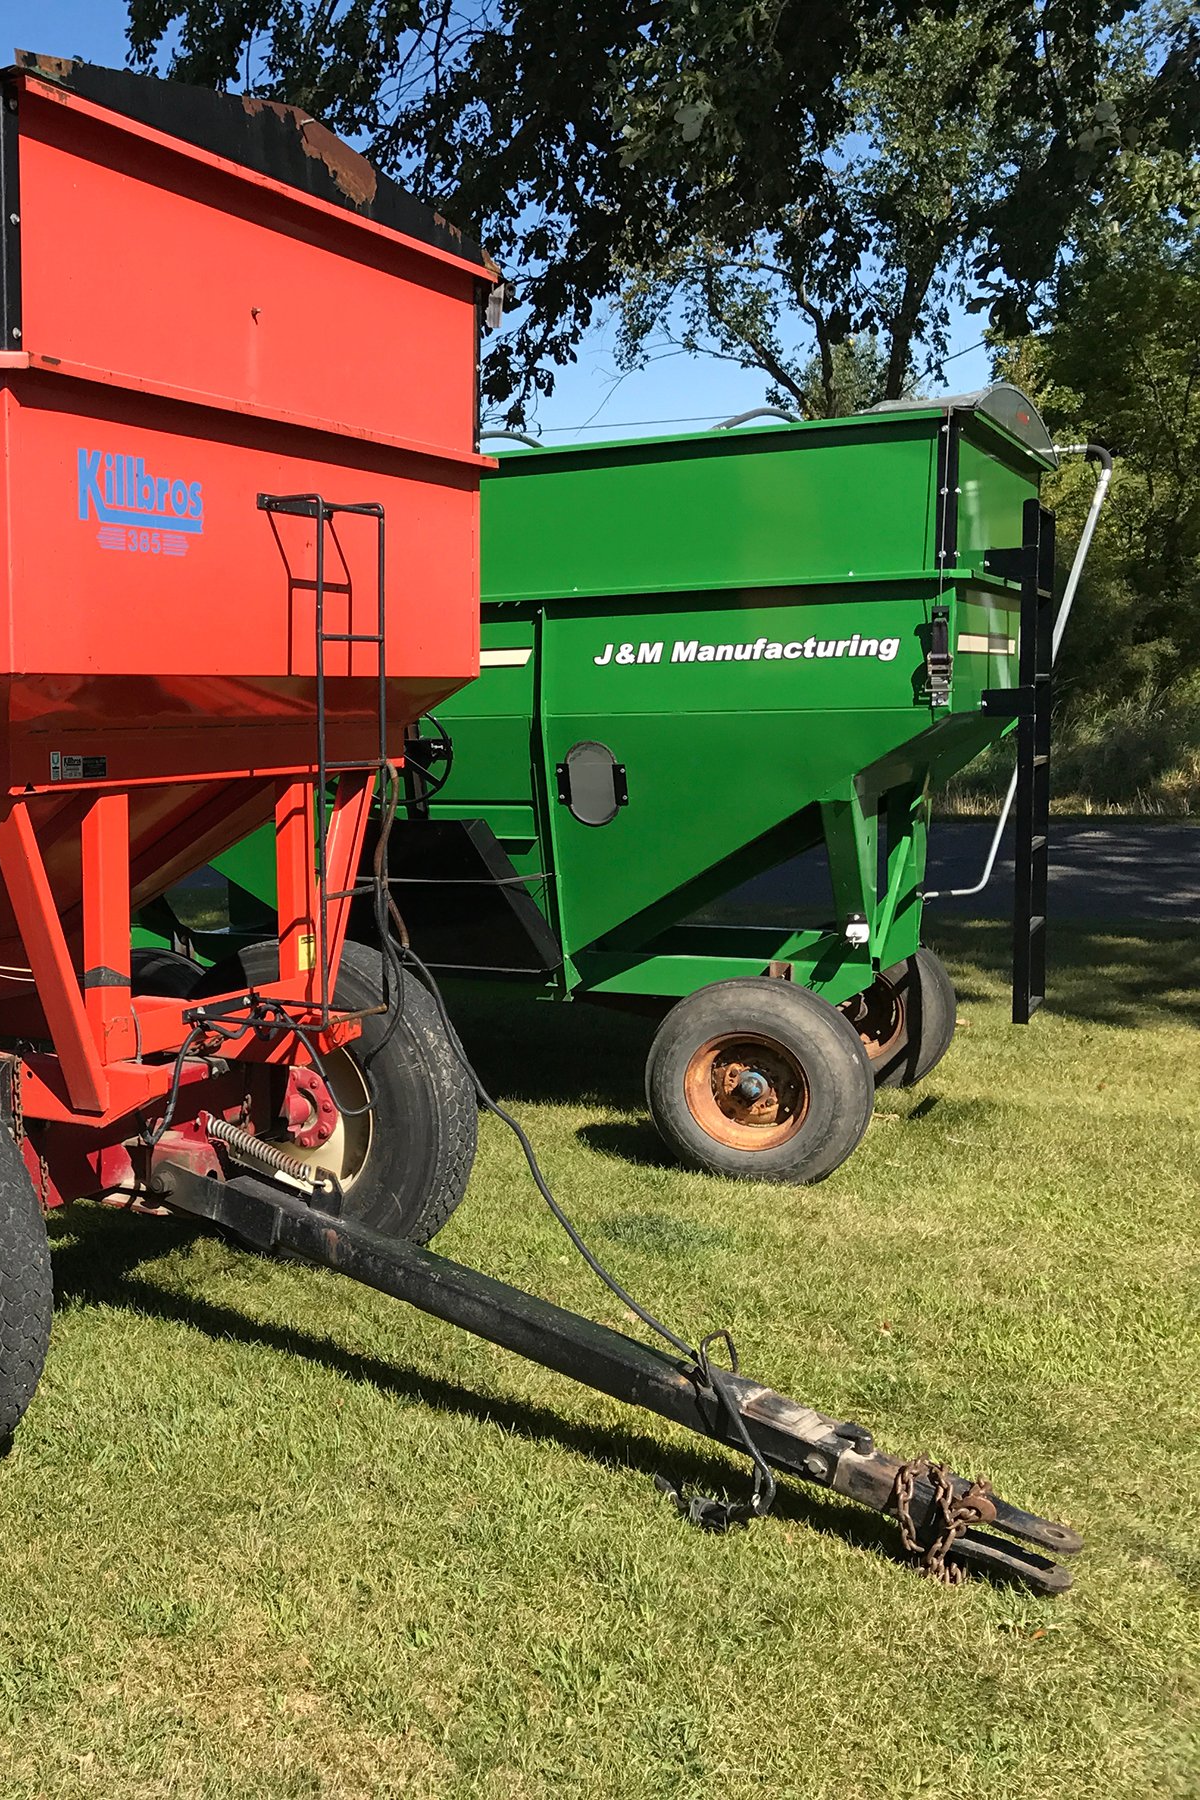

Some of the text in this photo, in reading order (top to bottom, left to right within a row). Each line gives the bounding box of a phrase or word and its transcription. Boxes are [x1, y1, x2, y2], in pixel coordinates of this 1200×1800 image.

[78, 448, 204, 524] Killbros
[128, 530, 161, 554] 385
[594, 634, 900, 666] J&M Manufacturing
